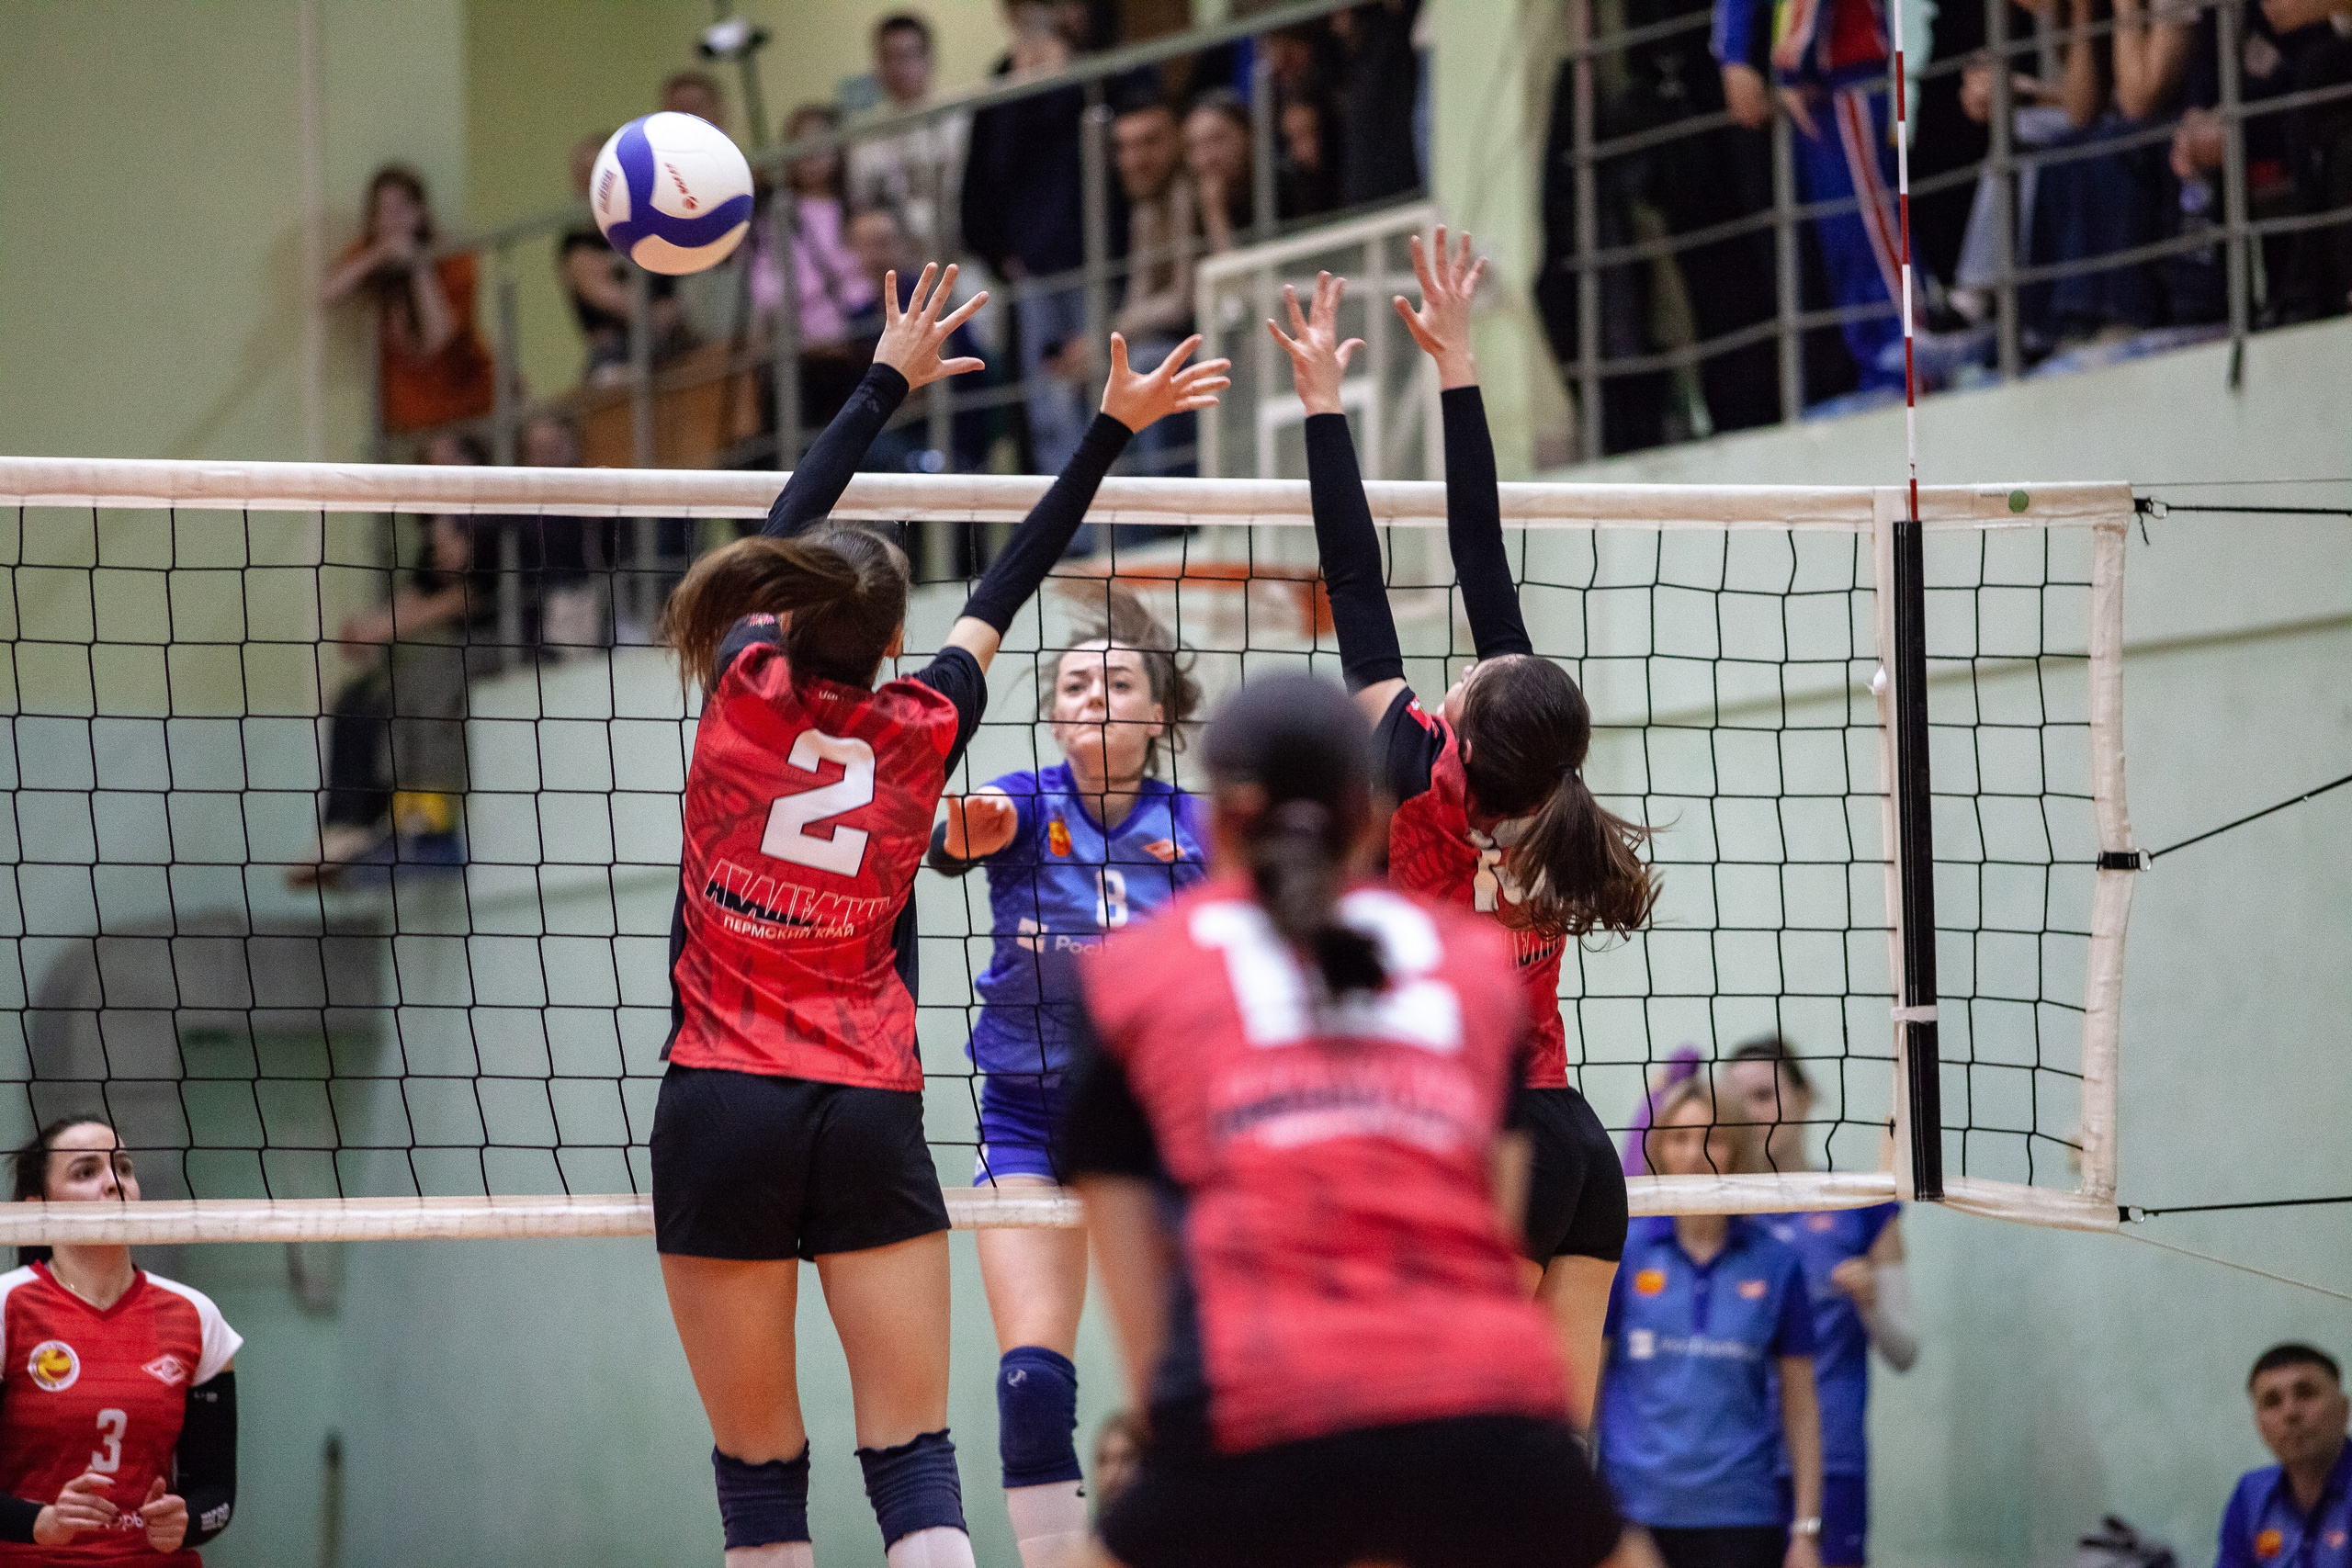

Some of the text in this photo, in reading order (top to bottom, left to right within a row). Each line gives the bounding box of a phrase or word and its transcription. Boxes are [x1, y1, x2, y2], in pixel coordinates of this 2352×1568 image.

[760, 728, 876, 878] 2
[723, 914, 855, 941] ПЕРМСКИЙ КРАЙ
[1095, 869, 1129, 928] 8
[1189, 887, 1466, 1055] 12
[91, 1408, 128, 1473] 3
